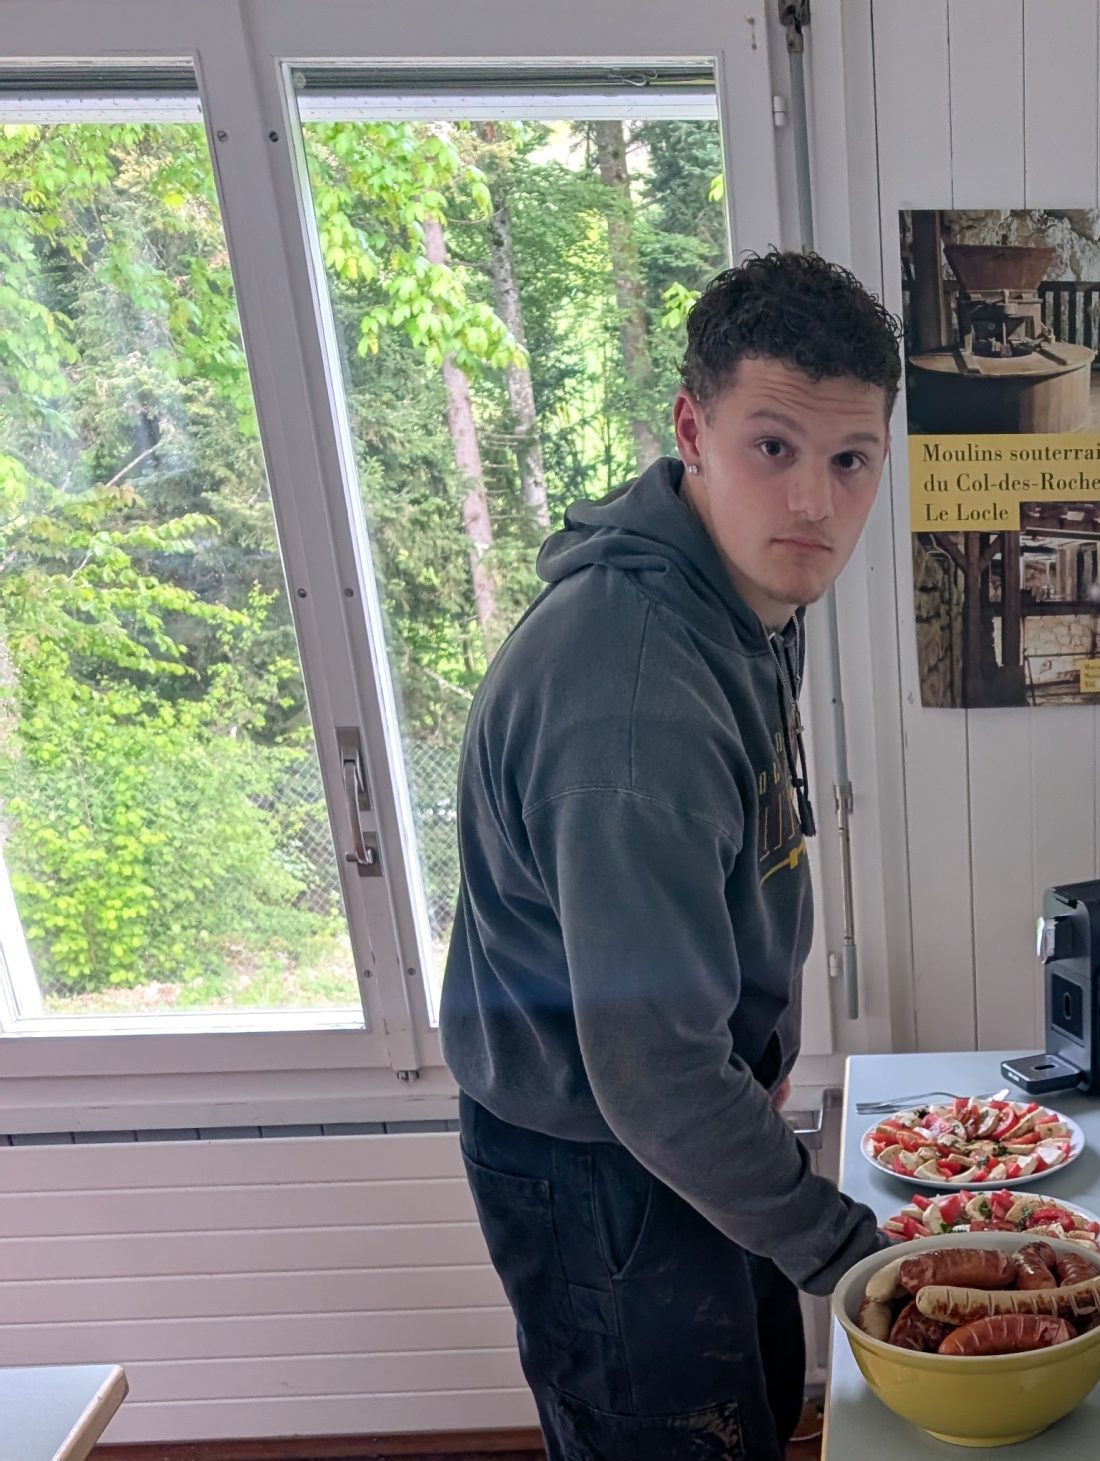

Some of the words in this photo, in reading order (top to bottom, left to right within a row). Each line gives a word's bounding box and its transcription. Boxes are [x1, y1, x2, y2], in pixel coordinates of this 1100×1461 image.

[923, 443, 1002, 462] Moulins
[924, 474, 949, 492] du
[925, 503, 949, 522] Le
[957, 503, 1009, 521] Locle
